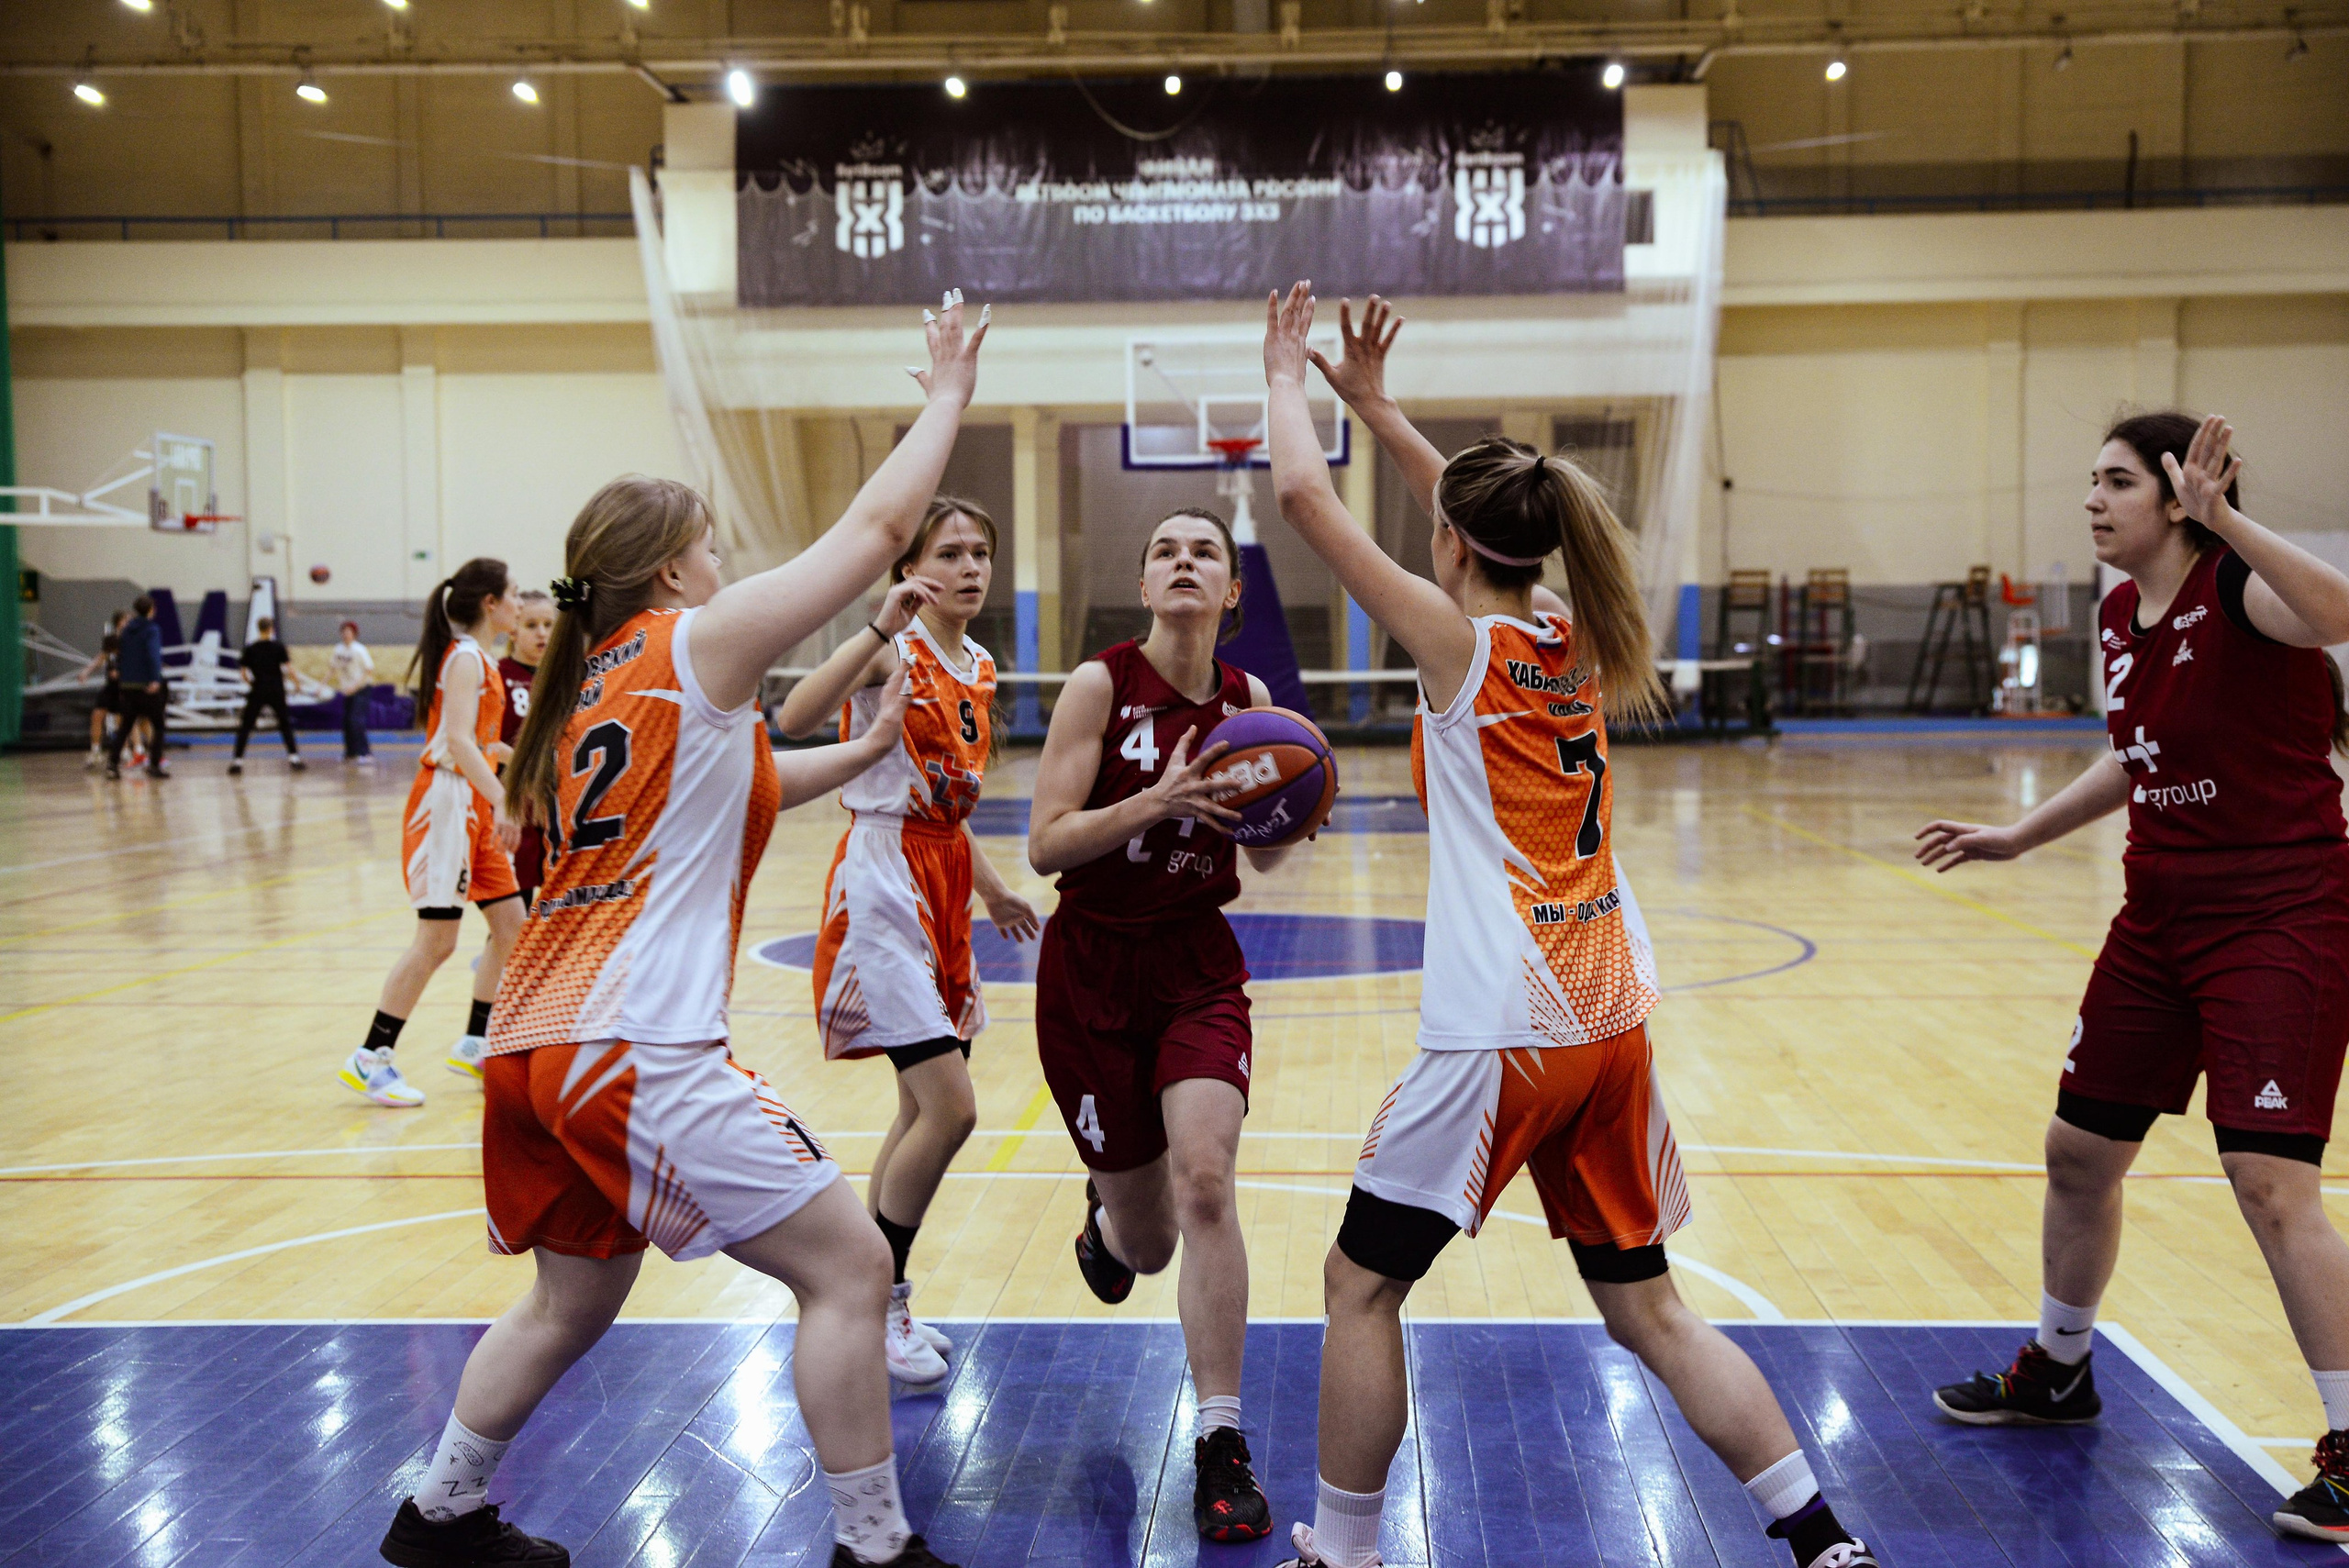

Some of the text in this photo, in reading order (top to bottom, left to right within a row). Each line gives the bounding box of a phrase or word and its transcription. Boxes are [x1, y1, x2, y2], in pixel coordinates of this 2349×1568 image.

[1073, 205, 1105, 224] ПО
[1108, 204, 1237, 224] БАСКЕТБОЛУ
[511, 687, 530, 717] 8
[958, 698, 980, 745] 9
[1119, 715, 1160, 773] 4
[1554, 728, 1606, 861] 7
[2148, 779, 2217, 812] group
[1167, 850, 1213, 879] grup
[1531, 903, 1565, 924] МЫ
[2254, 1095, 2288, 1109] PEAK
[1075, 1094, 1105, 1152] 4
[785, 1118, 822, 1162] 1
